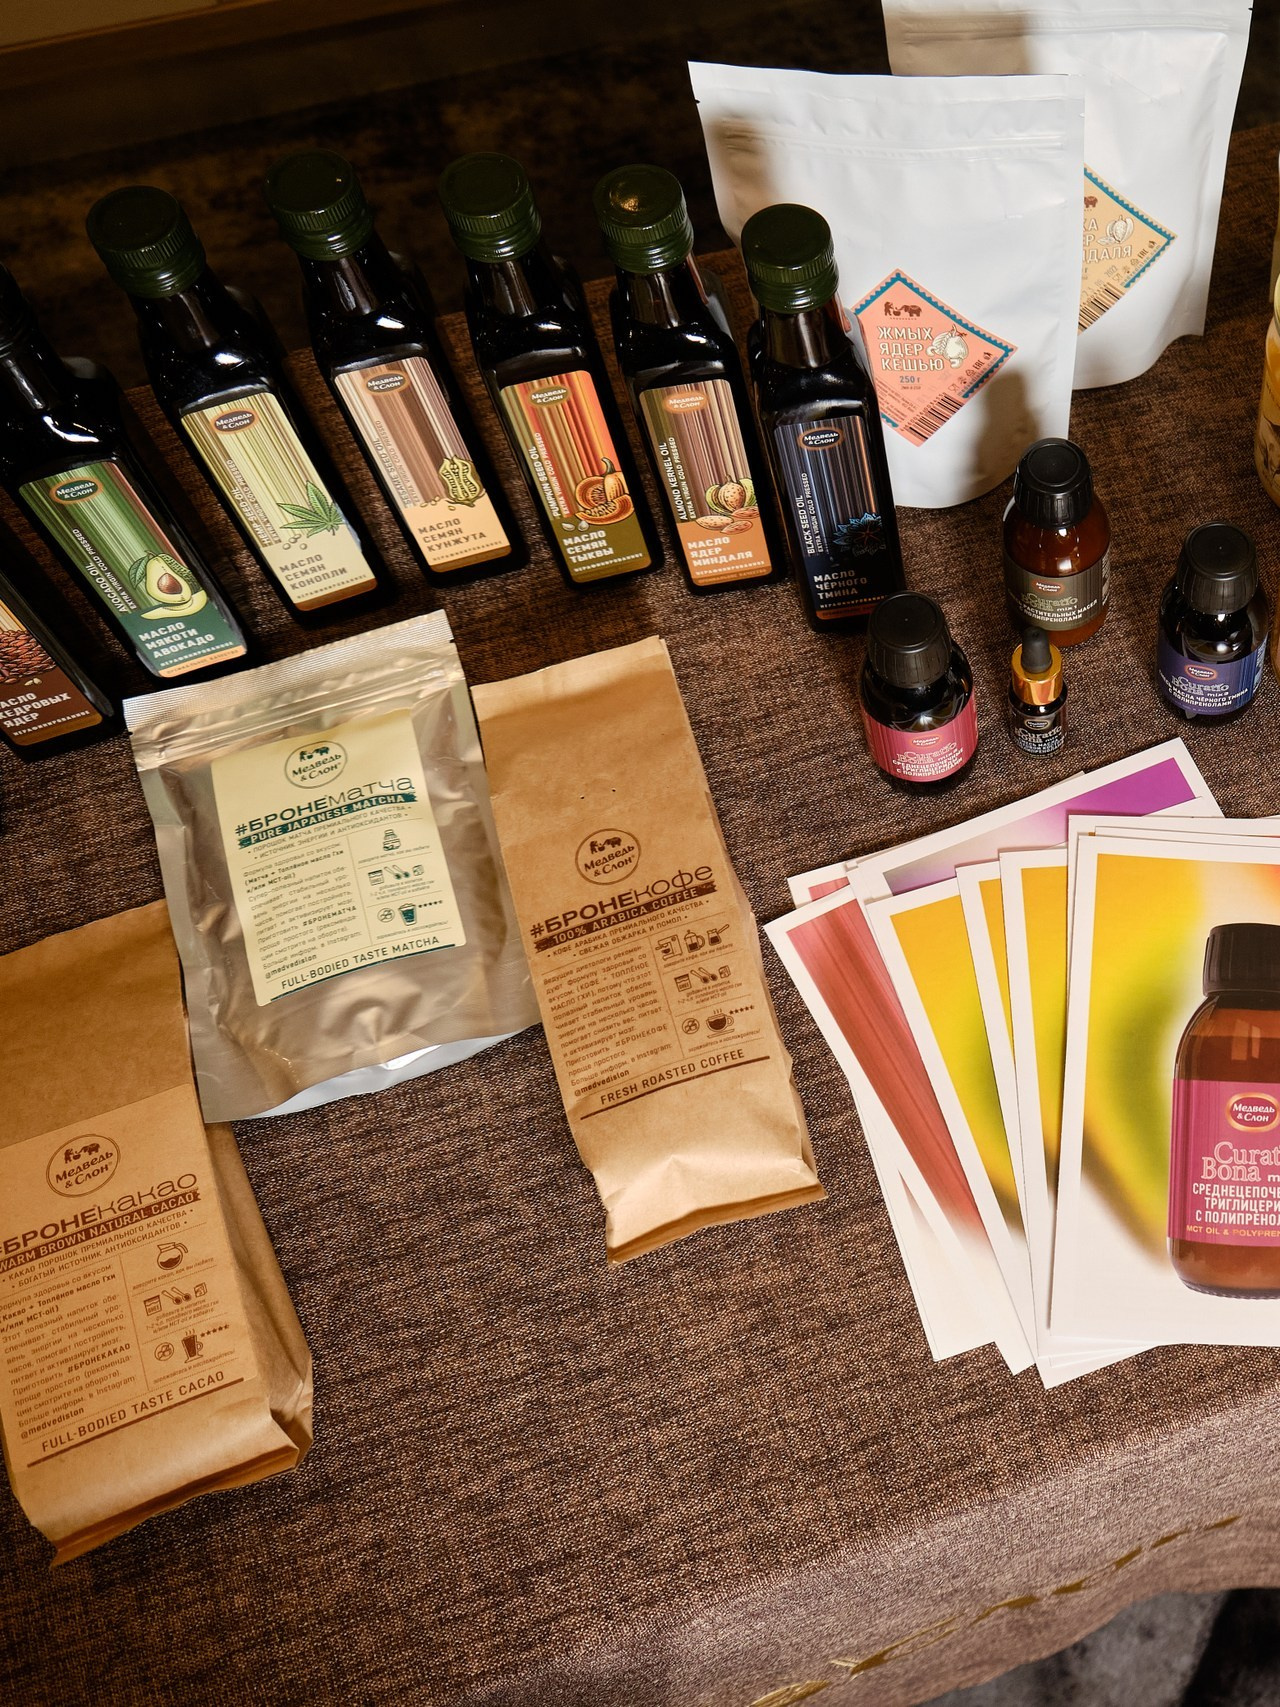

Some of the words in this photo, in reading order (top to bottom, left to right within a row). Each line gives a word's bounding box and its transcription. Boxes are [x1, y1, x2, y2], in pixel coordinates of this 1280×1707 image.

[877, 326, 934, 340] ЖМЫХ
[880, 343, 924, 357] ЯДЕР
[881, 357, 944, 372] КЕШЬЮ
[529, 446, 539, 460] OIL
[659, 443, 669, 456] OIL
[533, 461, 547, 481] SEED
[664, 457, 678, 488] KERNEL
[542, 483, 561, 517] PUMPKIN
[672, 489, 688, 520] ALMOND
[796, 496, 804, 508] OIL
[418, 517, 461, 535] МАСЛО
[799, 510, 809, 529] SEED
[72, 528, 96, 555] PRESSED
[423, 528, 463, 543] СЕМЯН
[427, 531, 487, 552] КУНЖУТА
[562, 530, 606, 546] МАСЛО
[687, 536, 731, 550] МАСЛО
[804, 530, 815, 554] BLACK
[566, 540, 608, 555] СЕМЯН
[569, 548, 614, 563] ТЫКВЫ
[690, 547, 723, 559] ЯДЕР
[93, 556, 107, 571] COLD
[279, 554, 323, 573] МАСЛО
[693, 551, 753, 567] МИНДАЛЯ
[86, 562, 98, 576] OIL
[285, 563, 326, 582] СЕМЯН
[290, 567, 348, 590] КОНОПЛИ
[814, 569, 855, 582] МАСЛО
[105, 572, 122, 591] VIRGIN
[815, 577, 867, 590] ЧЁРНОГО
[96, 577, 128, 612] AVOCADO
[120, 591, 137, 610] EXTRA
[818, 588, 858, 599] ТМИНА
[138, 622, 186, 641] МАСЛО
[145, 628, 198, 650] МЯКОТИ
[153, 634, 215, 659] АВОКАДО
[1228, 688, 1248, 700] ТМИНА
[3, 712, 39, 727] ЯДЕР
[251, 828, 283, 844] PURE
[286, 805, 349, 832] JAPANESE
[353, 795, 404, 811] MATCHA
[584, 845, 635, 872] Медведь
[602, 856, 632, 874] Слон
[552, 926, 587, 944] 100%
[592, 907, 648, 931] ARABICA
[652, 888, 698, 910] COFFEE
[553, 945, 572, 956] КОФЕ
[575, 933, 607, 949] АРАБИКА
[609, 912, 665, 935] ПРЕМИАЛЬНОГО
[667, 901, 703, 916] КАЧЕСТВА
[281, 959, 349, 990] FULL-BODIED
[352, 947, 389, 964] TASTE
[392, 936, 440, 954] MATCHA
[601, 1084, 638, 1105] FRESH
[642, 1063, 697, 1089] ROASTED
[700, 1049, 745, 1069] COFFEE
[1233, 1103, 1275, 1113] Медведь
[1244, 1113, 1269, 1122] Слон
[1201, 1156, 1261, 1182] Bona
[40, 1232, 86, 1257] BROWN
[90, 1209, 148, 1237] NATURAL
[151, 1192, 194, 1215] CACAO
[1196, 1210, 1201, 1222] С
[1187, 1225, 1203, 1233] MCT
[8, 1265, 36, 1281] КАКАО
[39, 1251, 78, 1269] ПОРОШОК
[80, 1226, 144, 1253] ПРЕМИАЛЬНОГО
[147, 1211, 187, 1229] КАЧЕСТВА
[18, 1268, 55, 1287] БОГАТЫЙ
[59, 1252, 102, 1271] ИСТОЧНИК
[105, 1222, 180, 1254] АНТИОКСИДАНТОВ
[42, 1410, 127, 1453] FULL-BODIED
[132, 1391, 174, 1414] TASTE
[178, 1371, 225, 1396] CACAO
